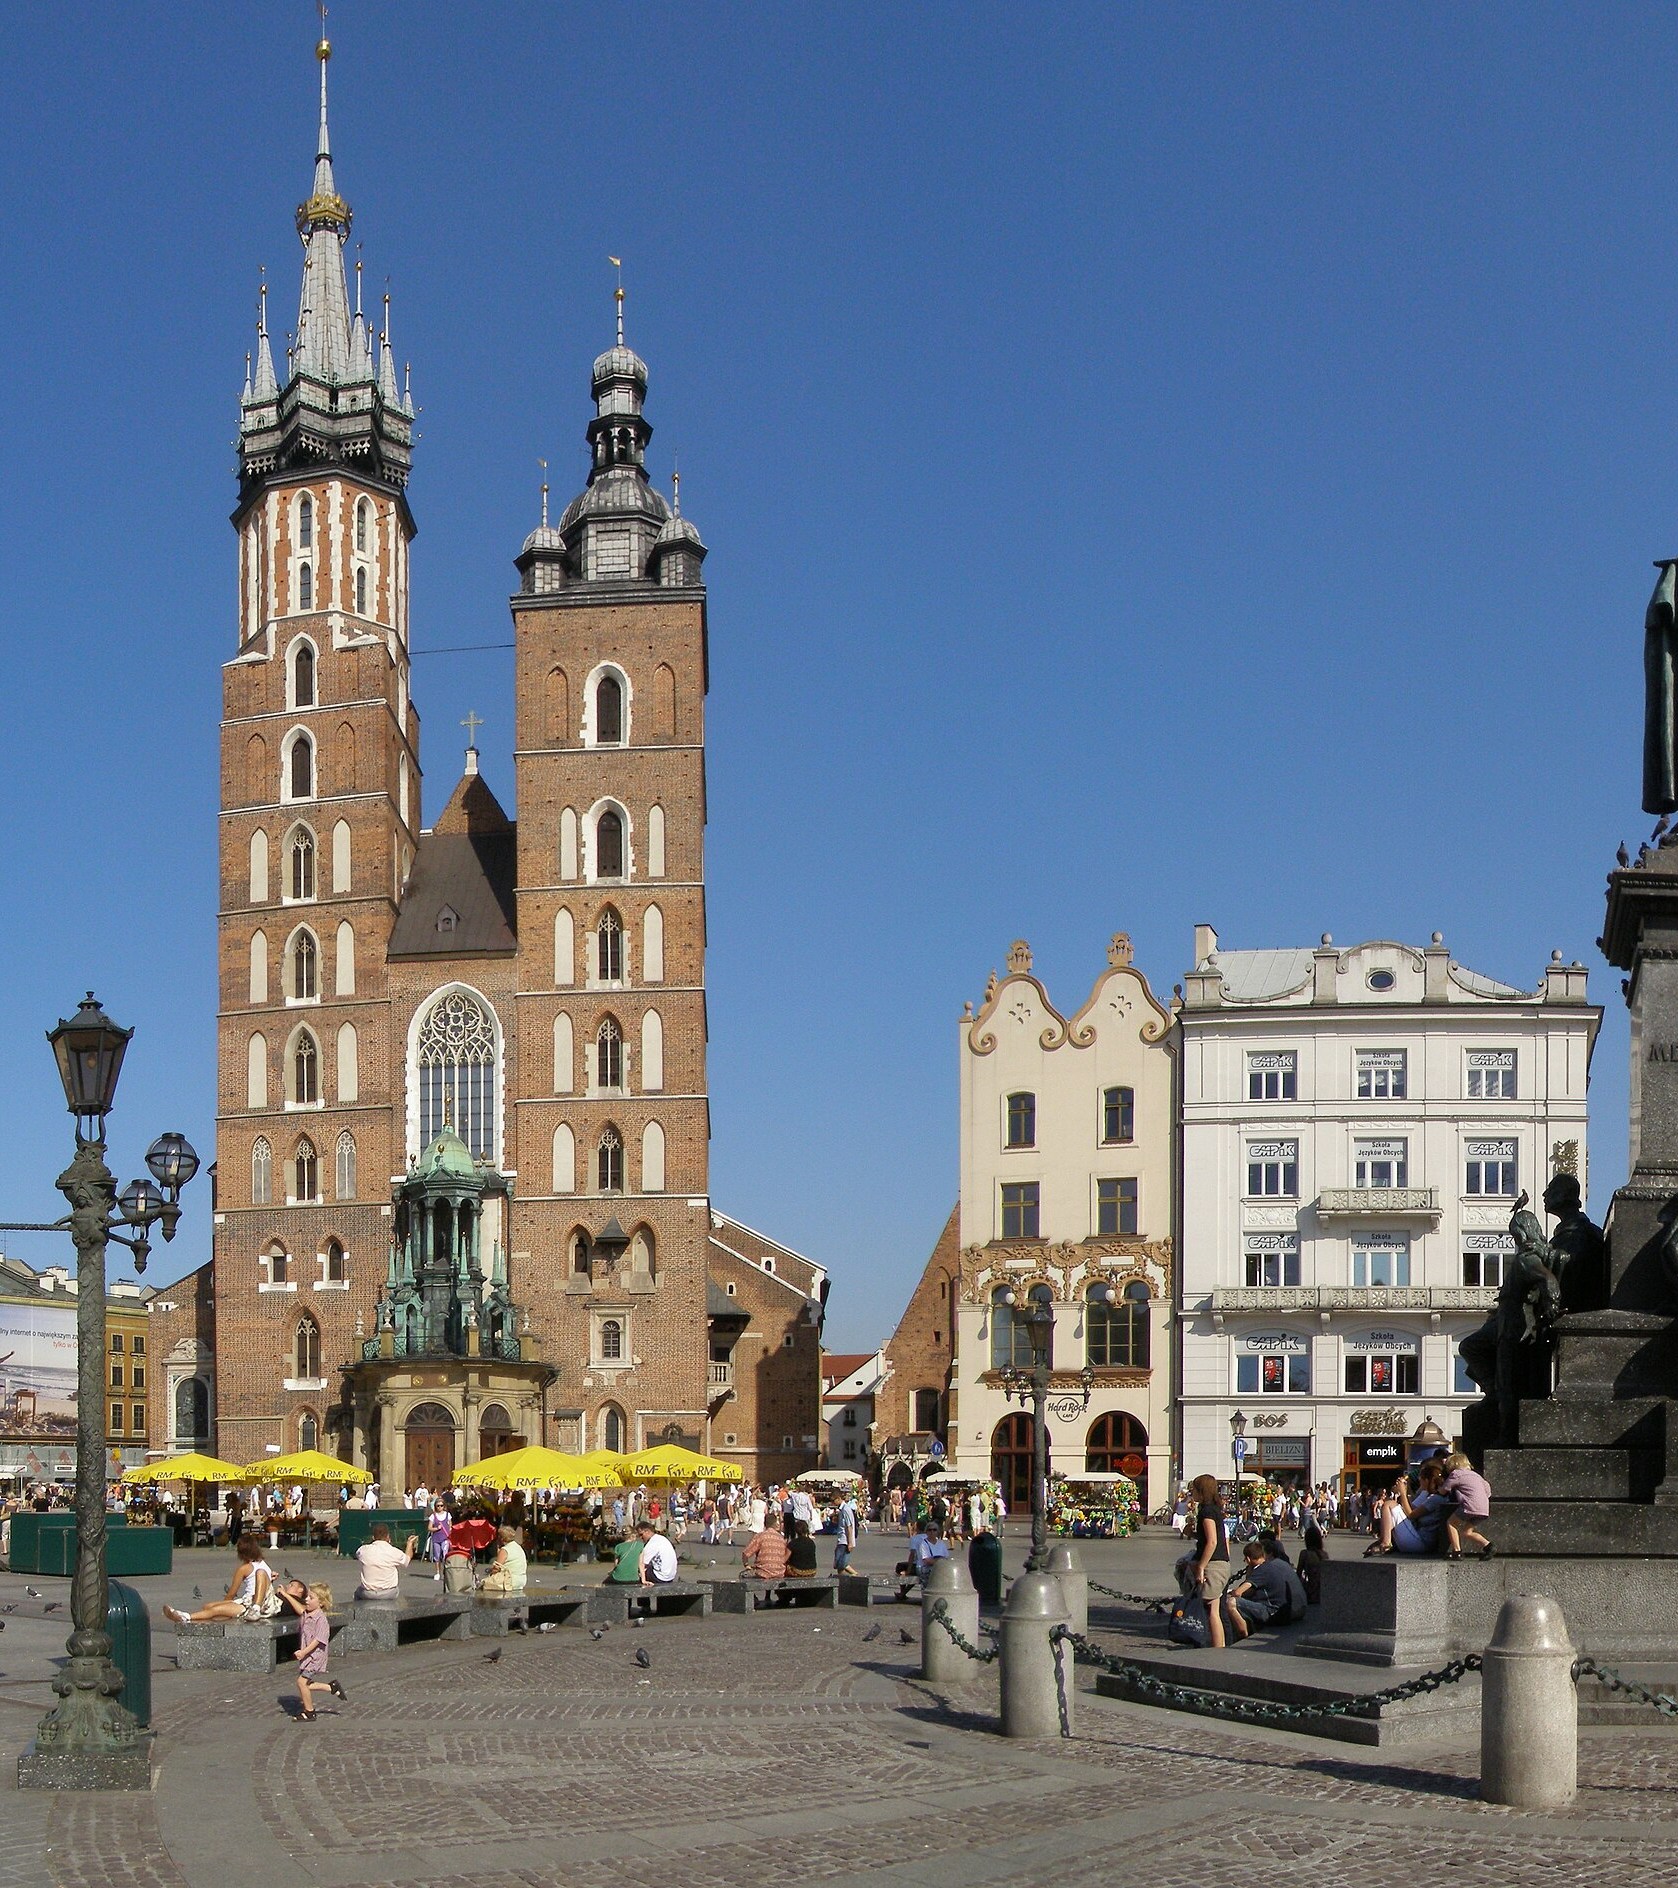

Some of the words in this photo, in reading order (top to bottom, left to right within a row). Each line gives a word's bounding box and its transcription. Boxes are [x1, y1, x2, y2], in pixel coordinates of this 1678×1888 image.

[10, 1328, 31, 1337] internet
[37, 1331, 72, 1340] największym
[1370, 1332, 1394, 1340] Szkoła
[53, 1341, 66, 1349] tylko
[1353, 1341, 1384, 1351] Języków
[1386, 1341, 1412, 1351] Obcych
[1047, 1402, 1067, 1412] Hard
[1068, 1402, 1088, 1413] Rock
[1366, 1445, 1398, 1457] empik
[276, 1466, 297, 1475] RMF
[635, 1464, 660, 1475] RMF
[697, 1465, 717, 1476] RMF
[156, 1471, 177, 1479] RMF
[212, 1472, 229, 1480] RMF
[456, 1474, 479, 1484] RMF
[515, 1477, 542, 1487] RMF
[586, 1475, 601, 1486] RMF
